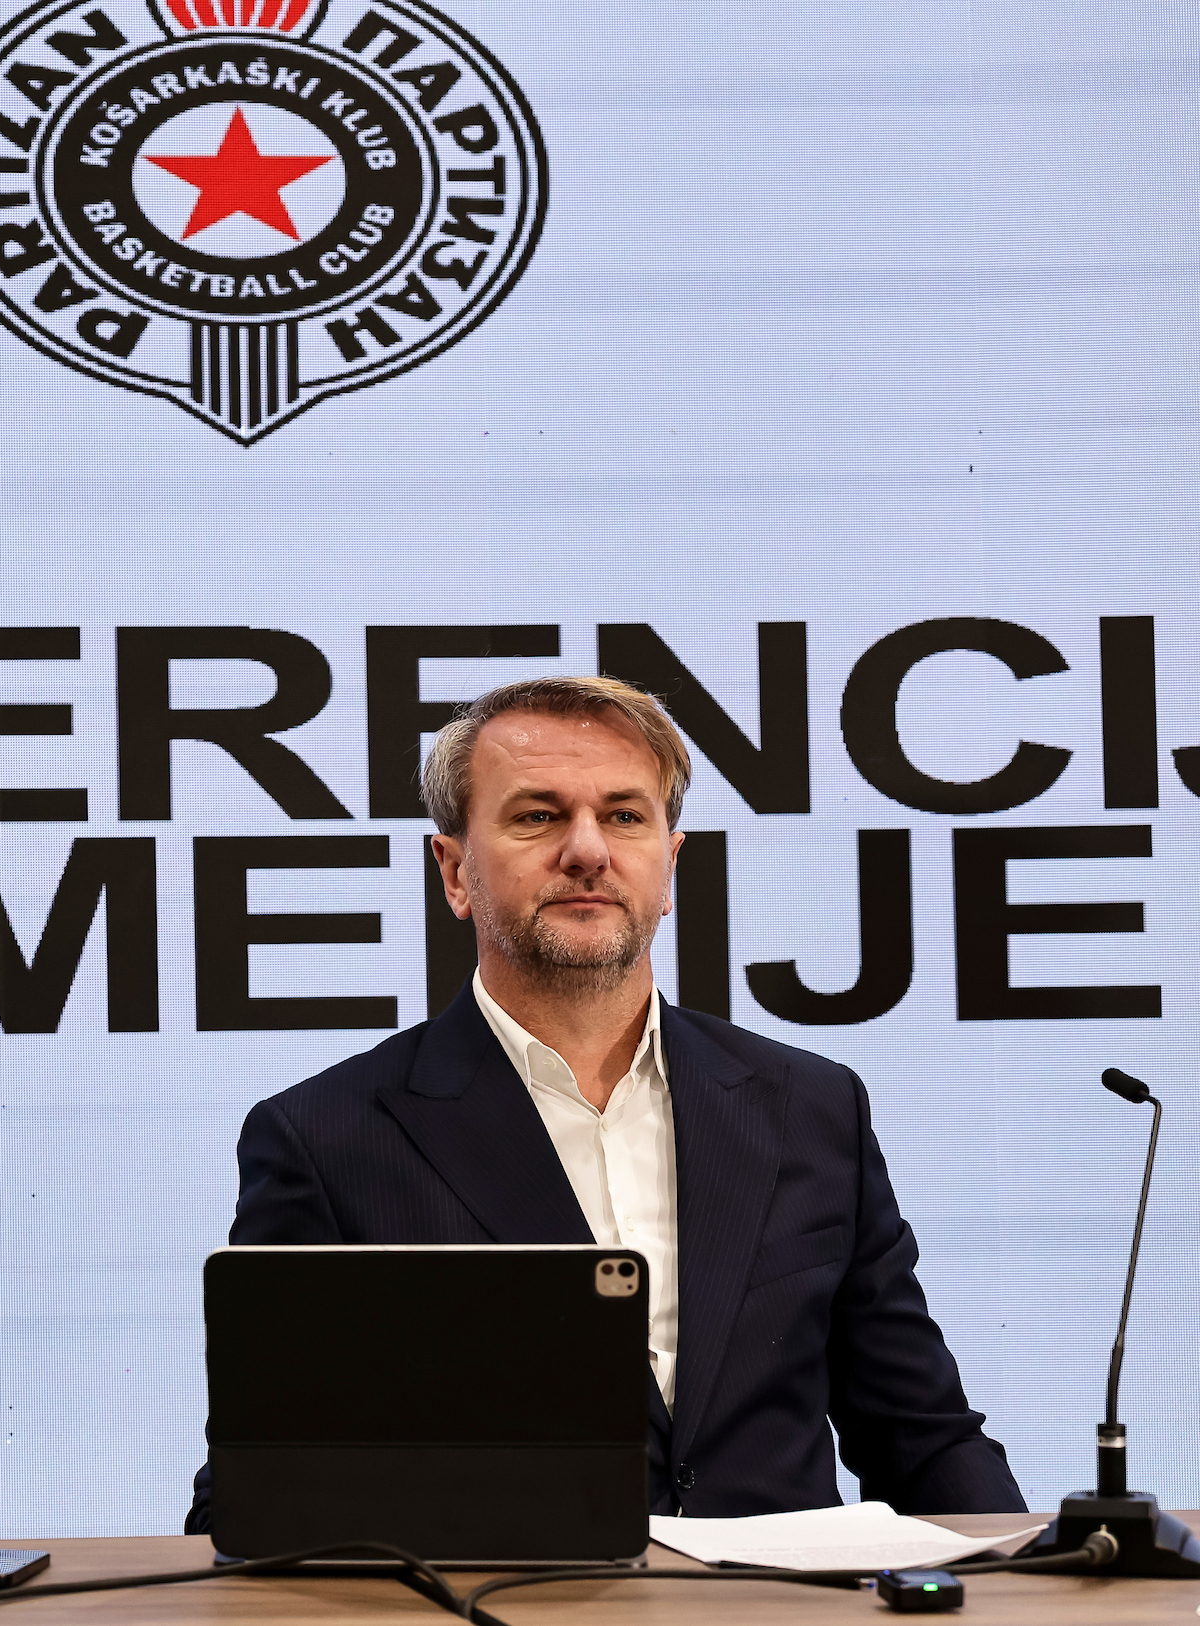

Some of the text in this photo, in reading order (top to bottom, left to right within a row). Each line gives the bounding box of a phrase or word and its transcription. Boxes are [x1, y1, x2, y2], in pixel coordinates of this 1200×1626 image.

[79, 57, 398, 171] KOŠARKAŠKI KLUB
[324, 11, 506, 362] ПАРТИЗАН
[82, 200, 395, 298] BASKETBALL CLUB
